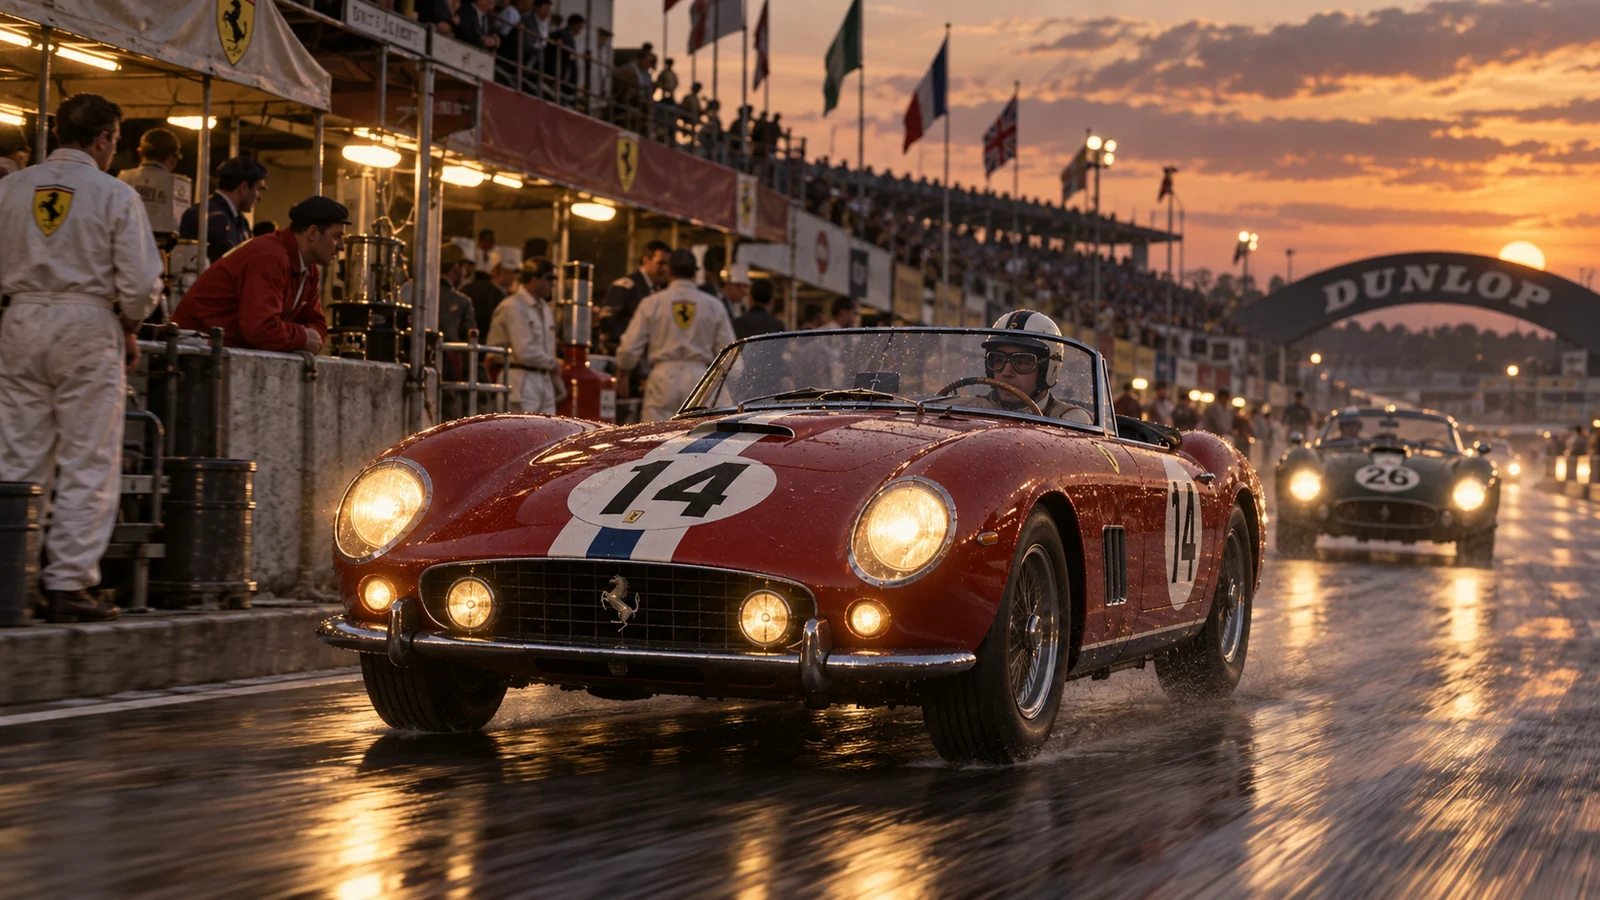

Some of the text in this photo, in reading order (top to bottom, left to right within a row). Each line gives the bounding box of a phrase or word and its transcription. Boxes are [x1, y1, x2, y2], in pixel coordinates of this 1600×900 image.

[1322, 263, 1551, 314] DUNLOP
[599, 460, 750, 518] 14
[1366, 467, 1409, 486] 26
[1171, 481, 1196, 584] 14
